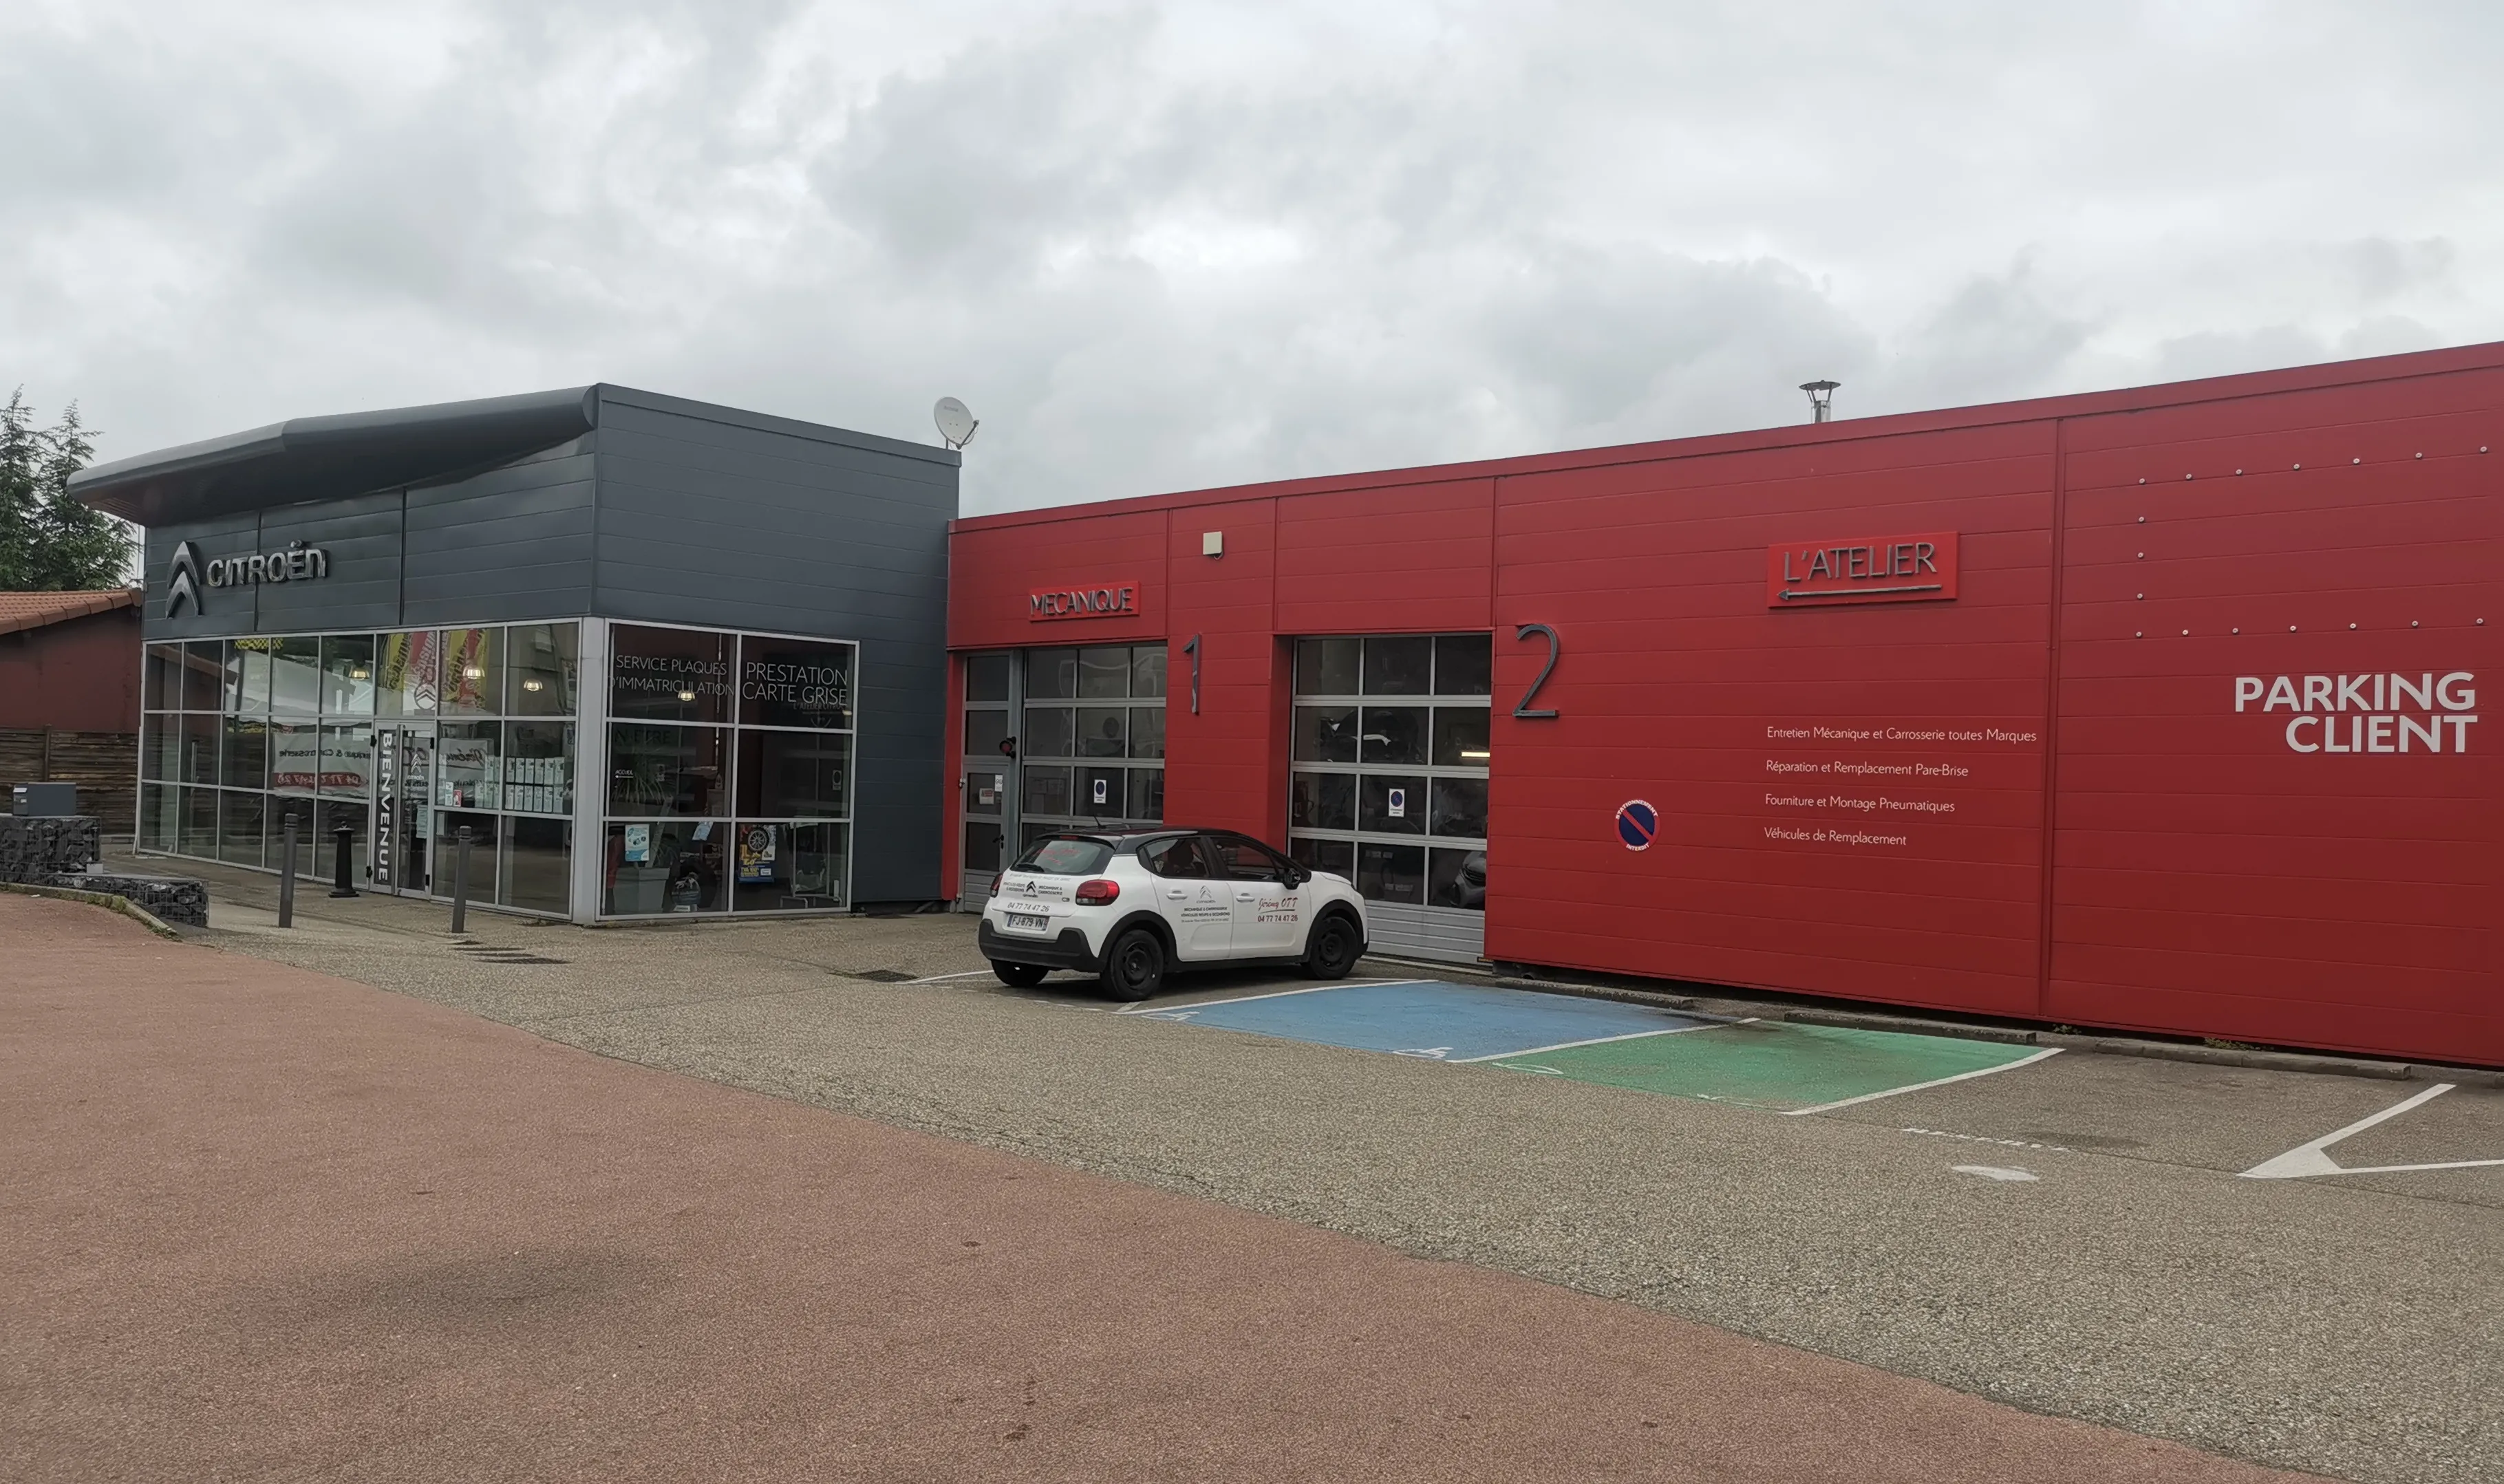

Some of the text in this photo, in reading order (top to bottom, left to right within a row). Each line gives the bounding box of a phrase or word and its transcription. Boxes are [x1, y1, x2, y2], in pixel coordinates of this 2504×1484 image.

[208, 539, 326, 587] CITROËN
[1784, 542, 1938, 583] L'ATELIER
[1030, 587, 1134, 616] MECANIQUE
[616, 654, 727, 676] SERVICE PLAQUES
[746, 661, 848, 687] PRESTATION
[1182, 633, 1201, 716] 1
[1512, 623, 1559, 718] 2
[742, 682, 848, 707] CARTE GRISE
[2234, 671, 2476, 712] PARKING
[1767, 726, 2037, 745] Entretien Mécanique et Carrosserie toutes Marques
[2285, 715, 2479, 753] CLIENT
[1766, 760, 1969, 777] Réparation et Remplacement Pare-Brise
[378, 733, 393, 881] BIENVENUE
[1765, 793, 1956, 814] Fourniture et Montage Pneumatiques
[1626, 842, 1649, 851] INTERDIT
[1764, 827, 1907, 846] Véhicules de Remplacement
[1281, 897, 1298, 907] OTT
[1012, 916, 1044, 928] FJ-879-VN
